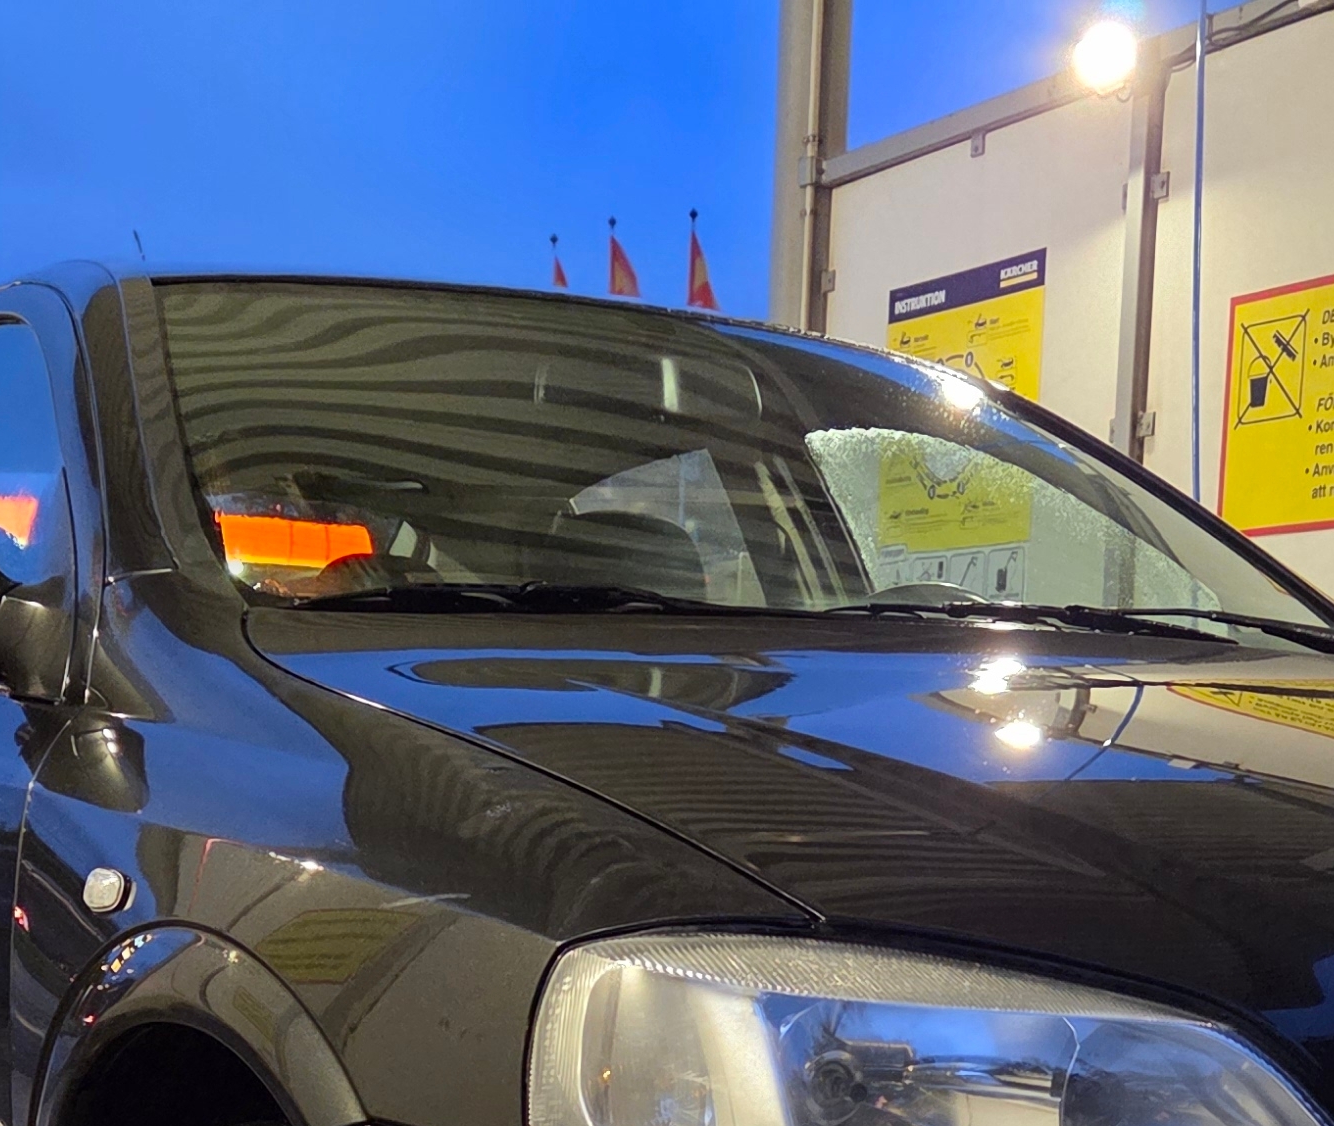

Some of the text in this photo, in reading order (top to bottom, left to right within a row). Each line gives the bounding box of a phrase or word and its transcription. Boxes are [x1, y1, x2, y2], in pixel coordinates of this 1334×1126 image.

[894, 289, 946, 315] INSTRUKTION
[1314, 442, 1333, 456] ren
[1311, 485, 1327, 499] att
